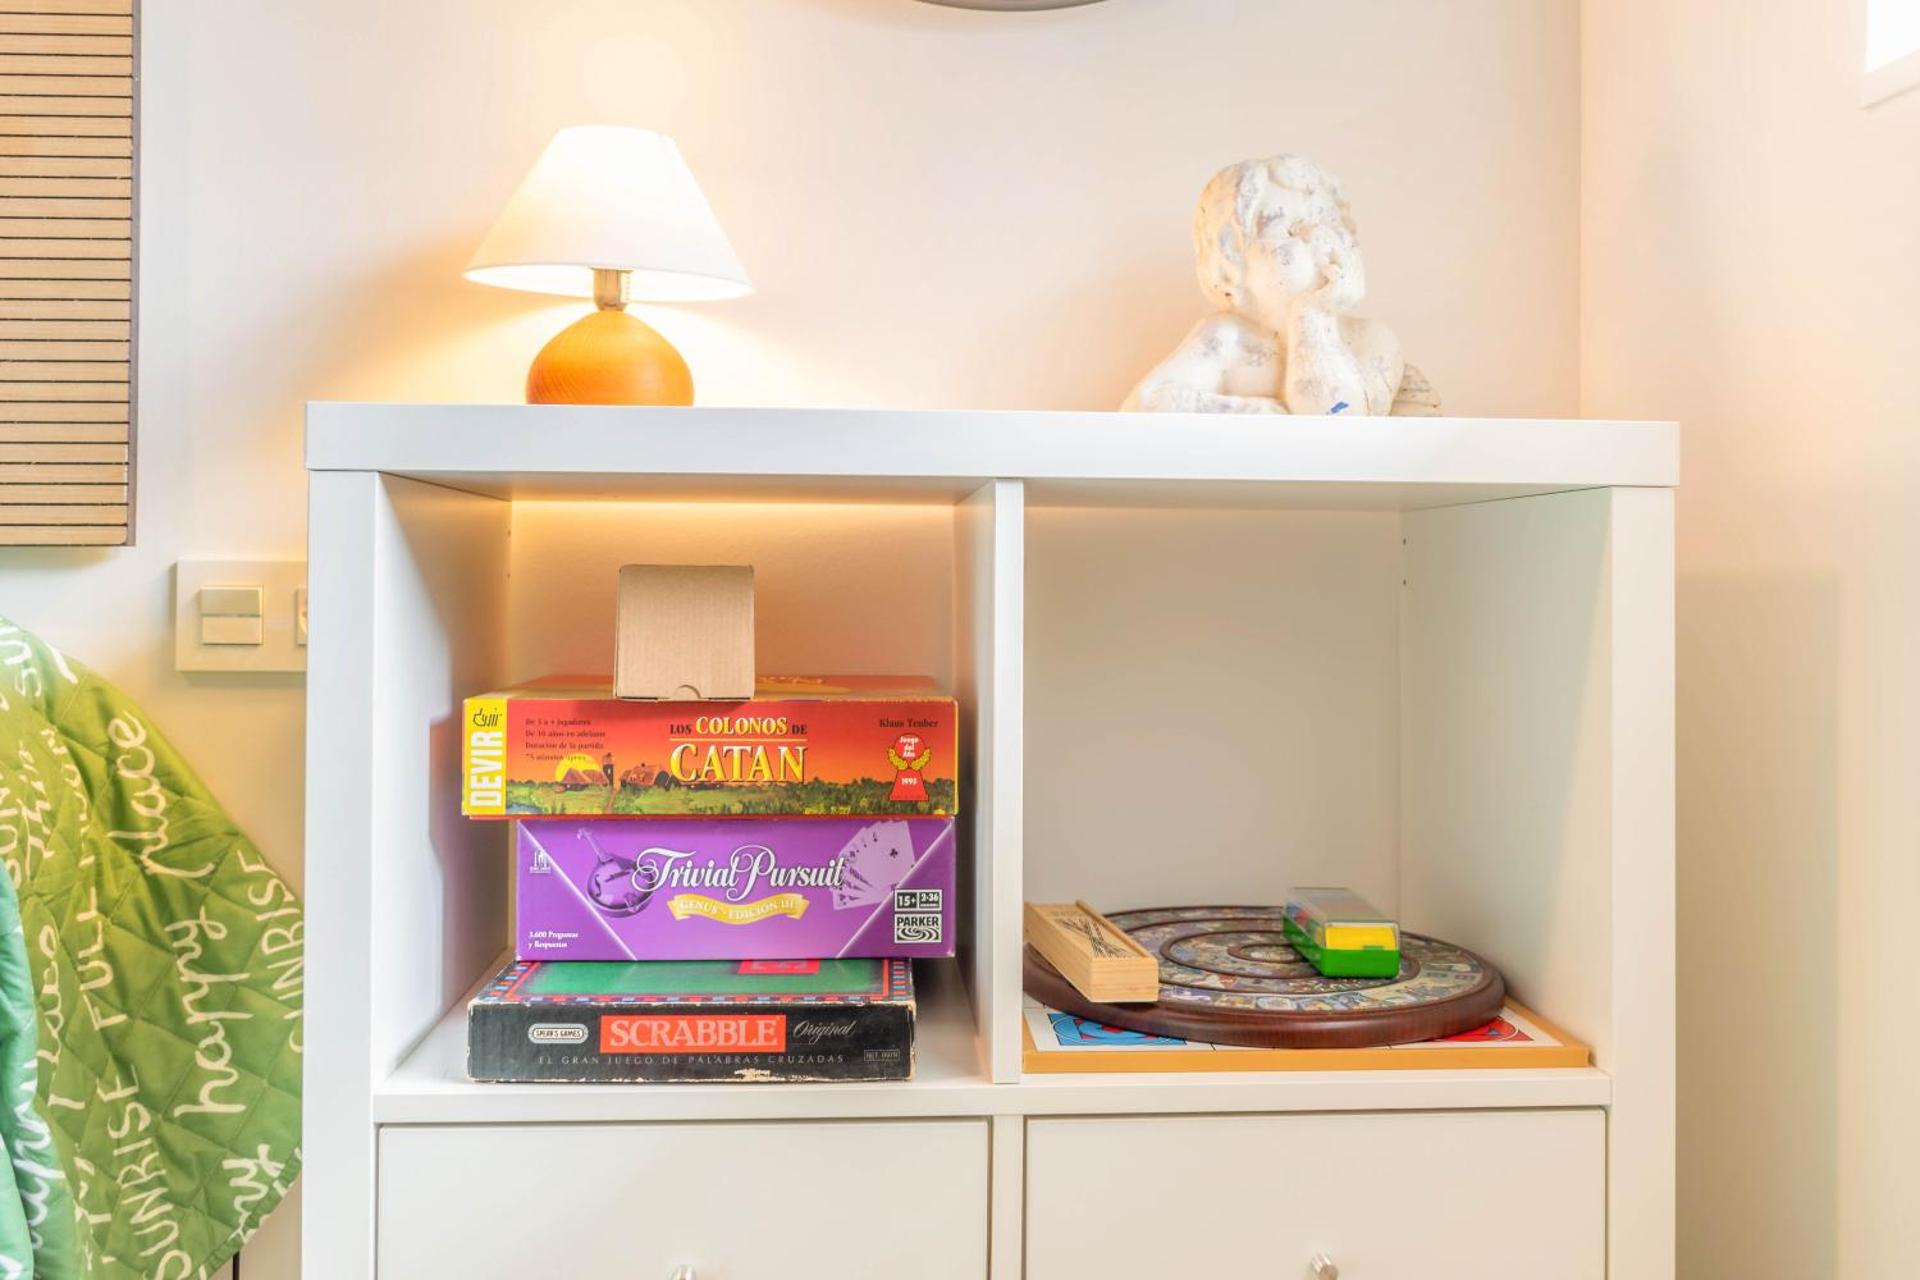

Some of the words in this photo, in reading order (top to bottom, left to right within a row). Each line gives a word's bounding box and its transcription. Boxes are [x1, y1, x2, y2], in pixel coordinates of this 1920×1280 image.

[670, 724, 692, 735] LOS
[695, 715, 789, 736] COLONOS
[791, 724, 808, 735] DE
[880, 719, 904, 728] Klaus
[907, 719, 938, 728] Teuber
[470, 731, 503, 807] DEVIR
[669, 743, 809, 784] CATAN
[106, 710, 216, 879] place
[631, 847, 740, 892] Trivial
[726, 845, 846, 902] Pursuit
[680, 900, 719, 914] GENUS
[896, 916, 940, 927] PARKER
[76, 886, 128, 1032] FULL
[164, 905, 255, 1119] happy
[560, 1030, 581, 1038] GAMES
[609, 1019, 778, 1048] SCRABBLE
[793, 1020, 857, 1046] Original
[538, 1055, 553, 1065] EL
[561, 1055, 600, 1065] GRAN
[607, 1055, 654, 1065] JUEGO
[662, 1055, 679, 1065] DE
[688, 1055, 759, 1065] PALABRAS
[768, 1054, 845, 1065] CRUZADAS
[96, 1064, 192, 1280] SUNRISE
